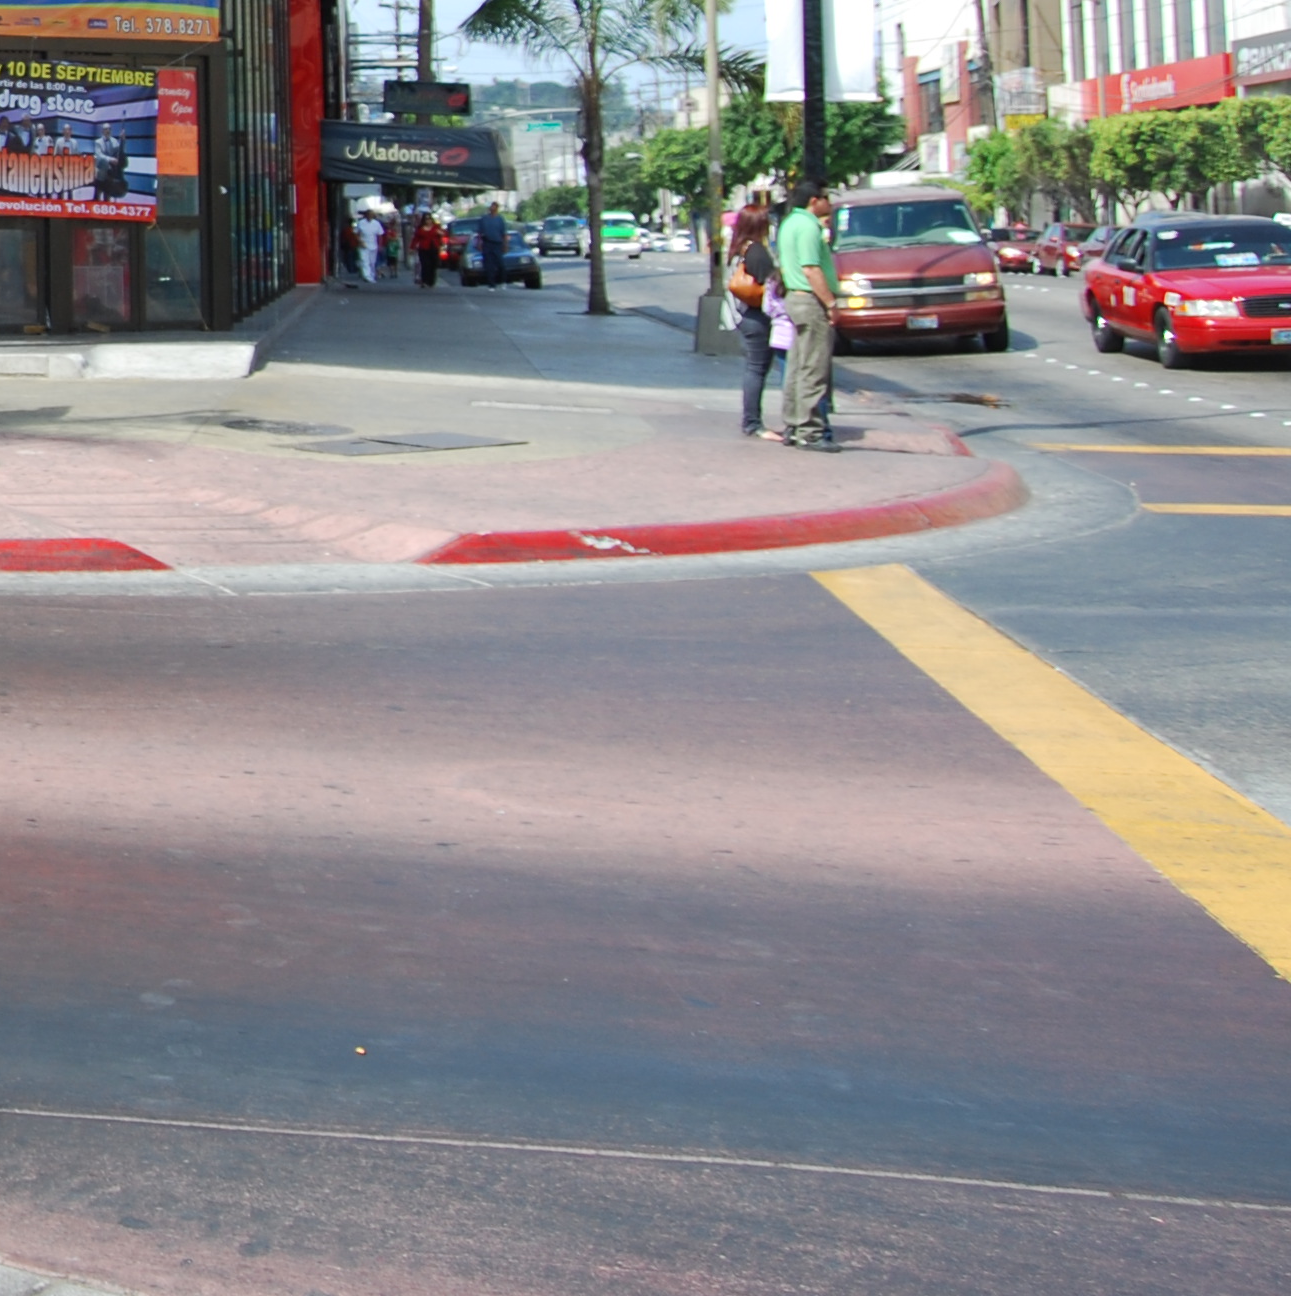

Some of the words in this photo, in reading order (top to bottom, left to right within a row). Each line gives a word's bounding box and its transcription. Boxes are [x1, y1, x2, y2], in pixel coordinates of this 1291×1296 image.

[114, 16, 141, 34] Tel.
[146, 17, 211, 35] 378.8271
[7, 61, 26, 77] 10
[30, 62, 52, 79] DE
[56, 64, 155, 87] SEPTIEMBRE
[16, 79, 28, 89] de
[30, 80, 44, 90] las
[46, 81, 66, 92] 8:00
[47, 94, 96, 114] store
[171, 101, 194, 115] Open
[346, 139, 439, 165] Madonas
[66, 201, 90, 215] Tel.
[92, 204, 152, 217] 680-4377
